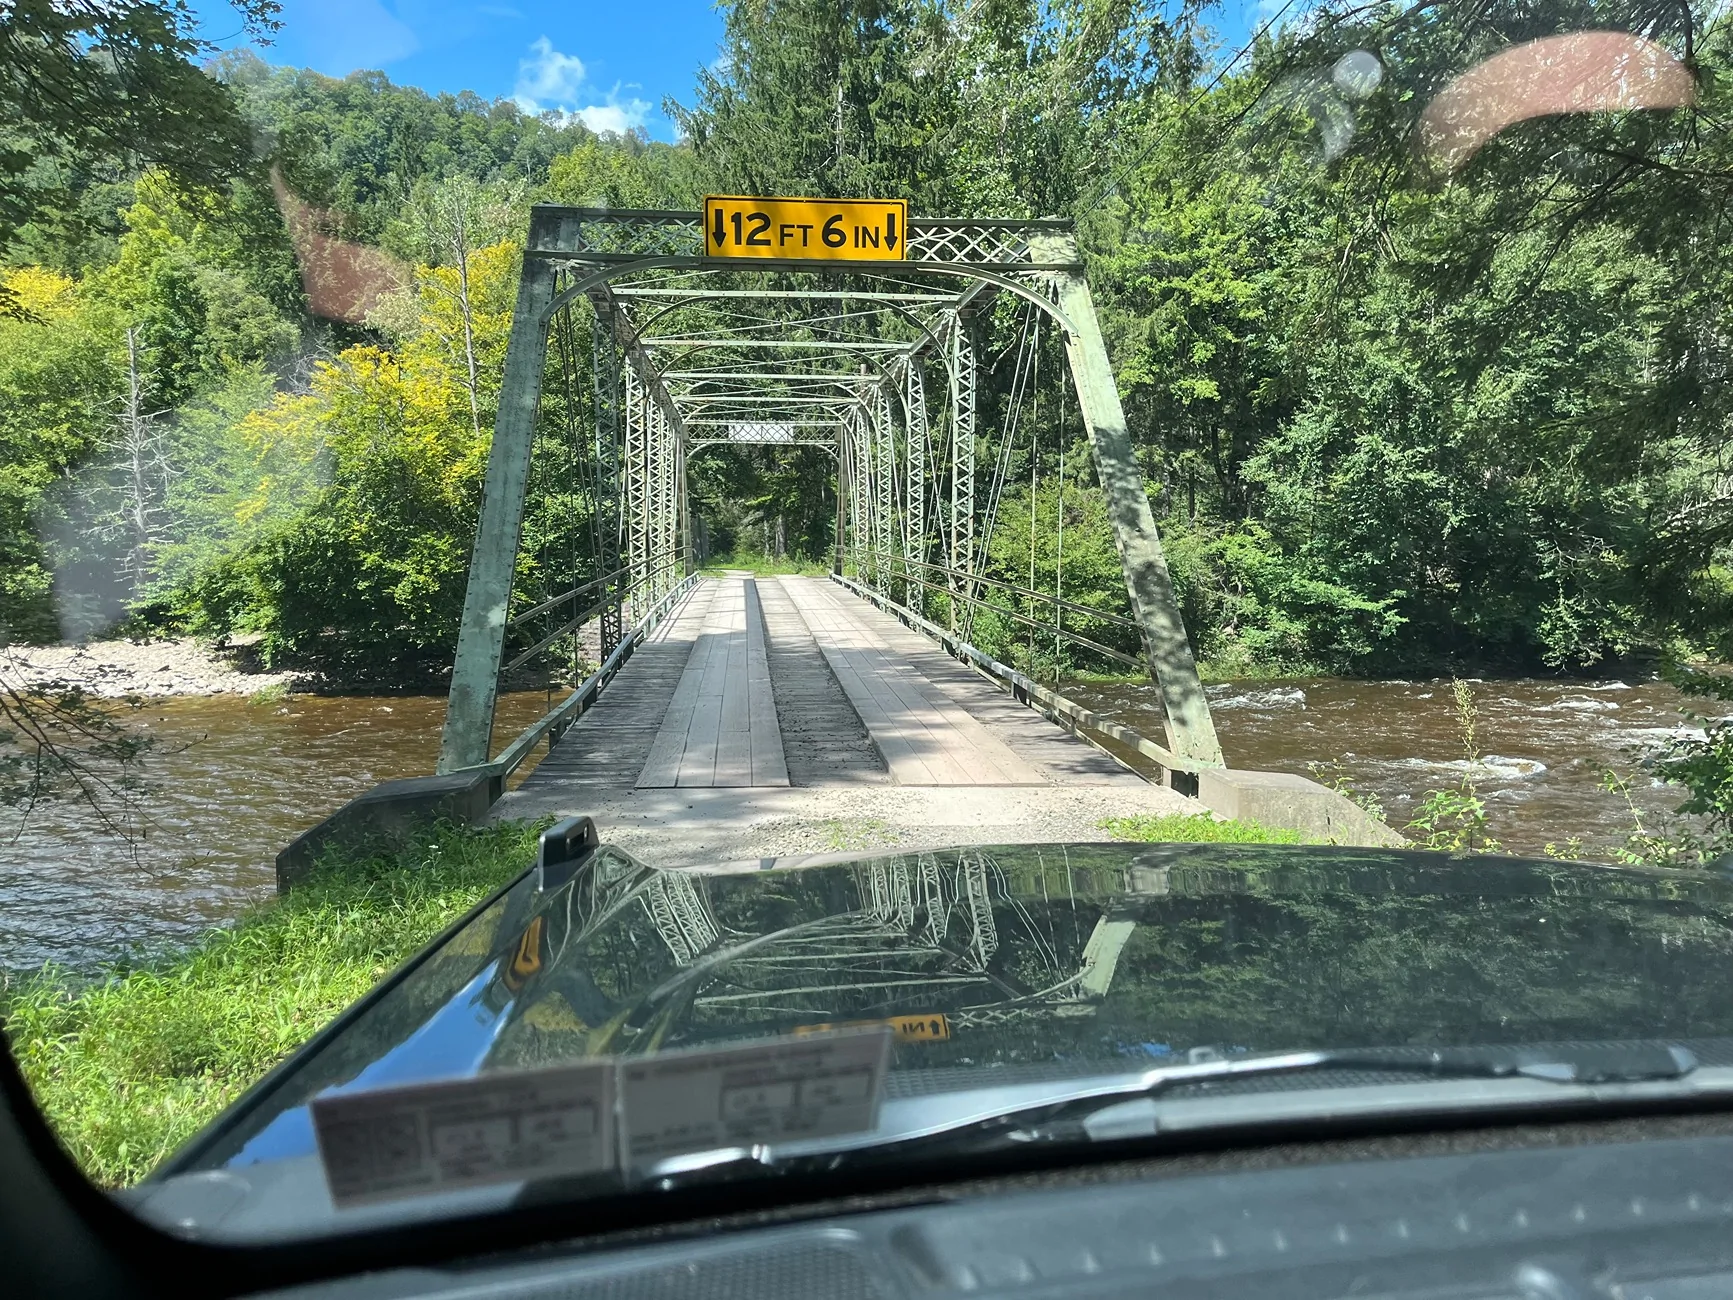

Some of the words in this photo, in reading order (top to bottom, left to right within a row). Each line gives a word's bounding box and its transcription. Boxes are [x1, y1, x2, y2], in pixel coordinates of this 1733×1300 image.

[731, 211, 772, 246] 12
[779, 224, 814, 247] FT
[821, 214, 847, 248] 6
[854, 226, 879, 248] IN
